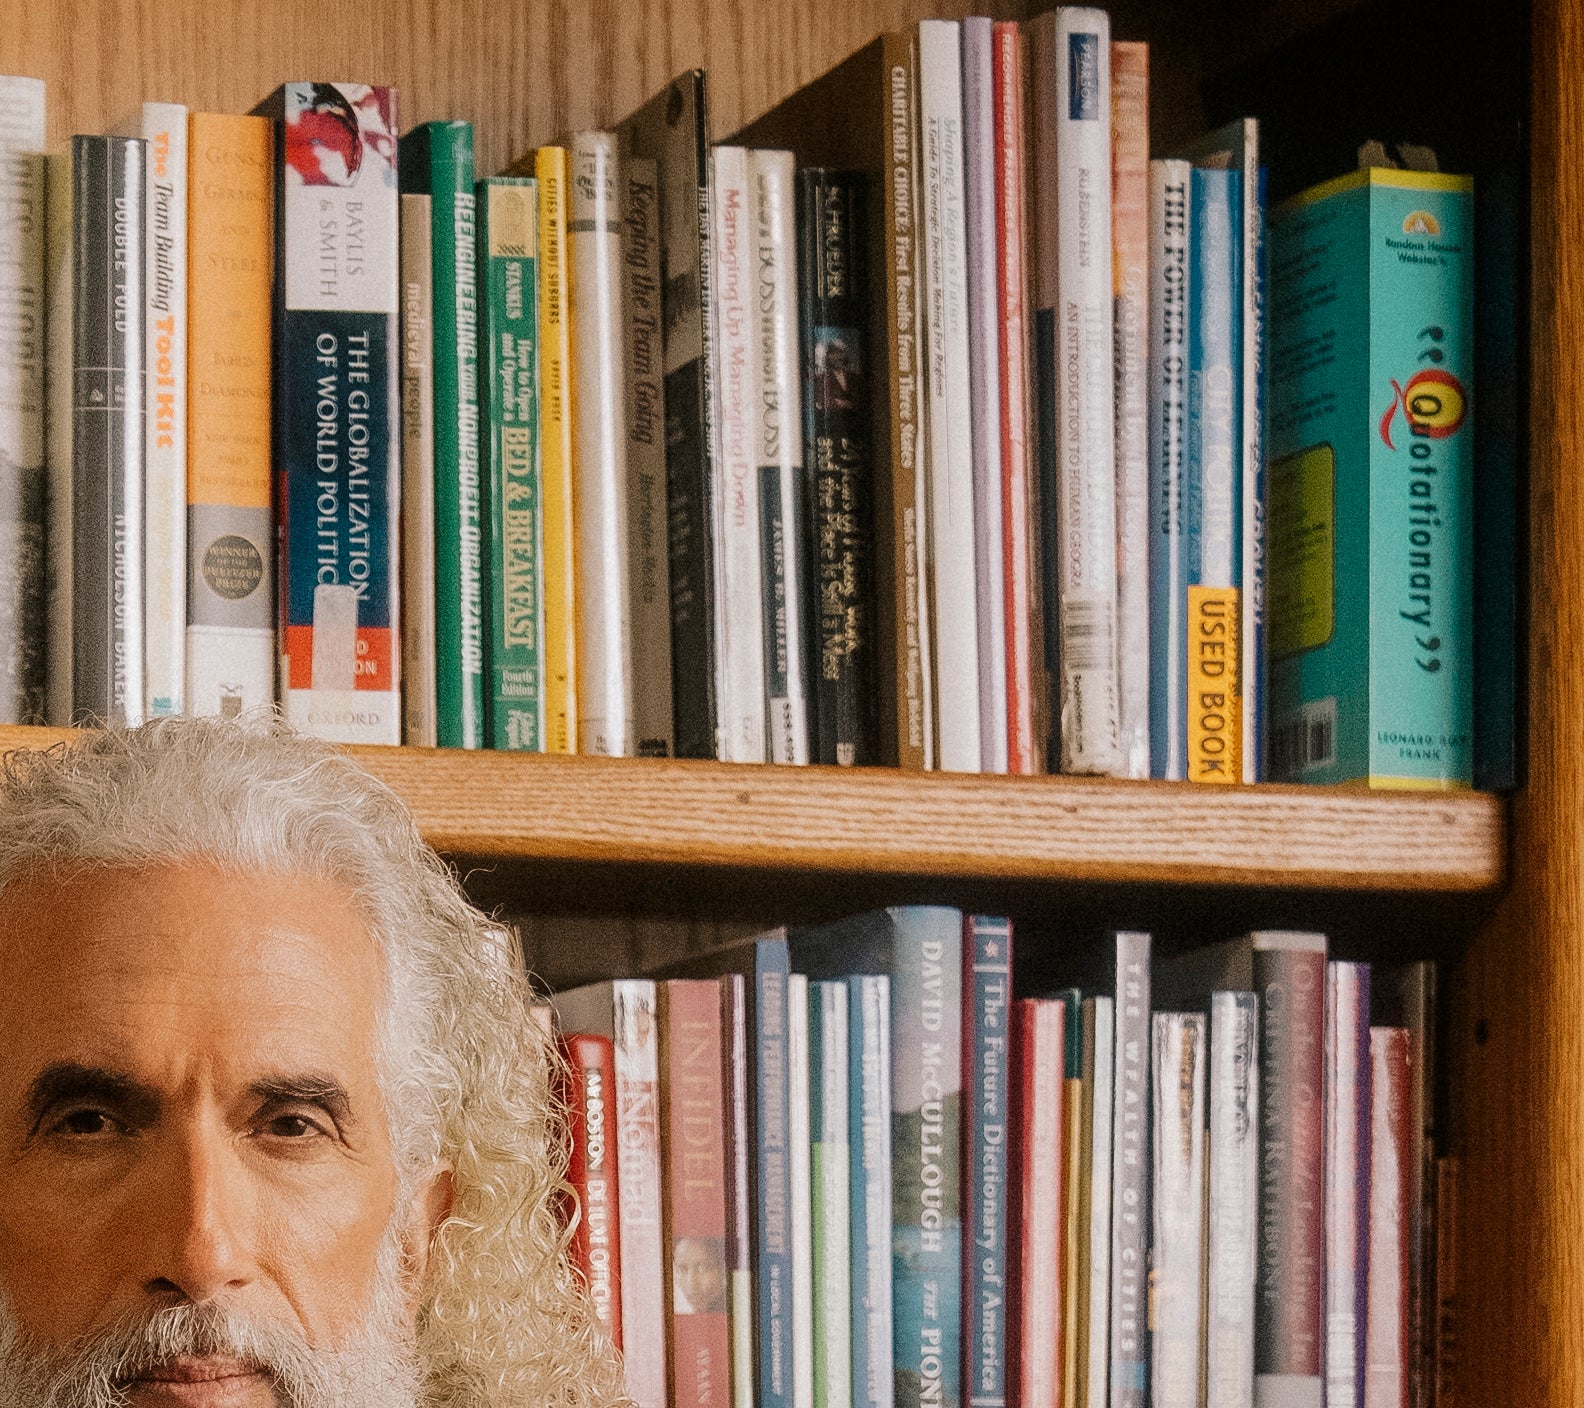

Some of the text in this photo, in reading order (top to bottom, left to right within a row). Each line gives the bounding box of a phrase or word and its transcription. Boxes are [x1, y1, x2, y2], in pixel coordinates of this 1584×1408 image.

[319, 199, 337, 299] & SMITH
[346, 201, 364, 276] BAYLIS
[316, 332, 338, 365] OF
[316, 375, 338, 472] WORLD
[348, 332, 370, 602] THE GLOBALIZATION
[1400, 394, 1443, 628] Quotationary
[1200, 601, 1226, 776] USED BOOK
[921, 942, 943, 1031] DAVID
[976, 980, 1004, 1391] The Future Dictionary of America
